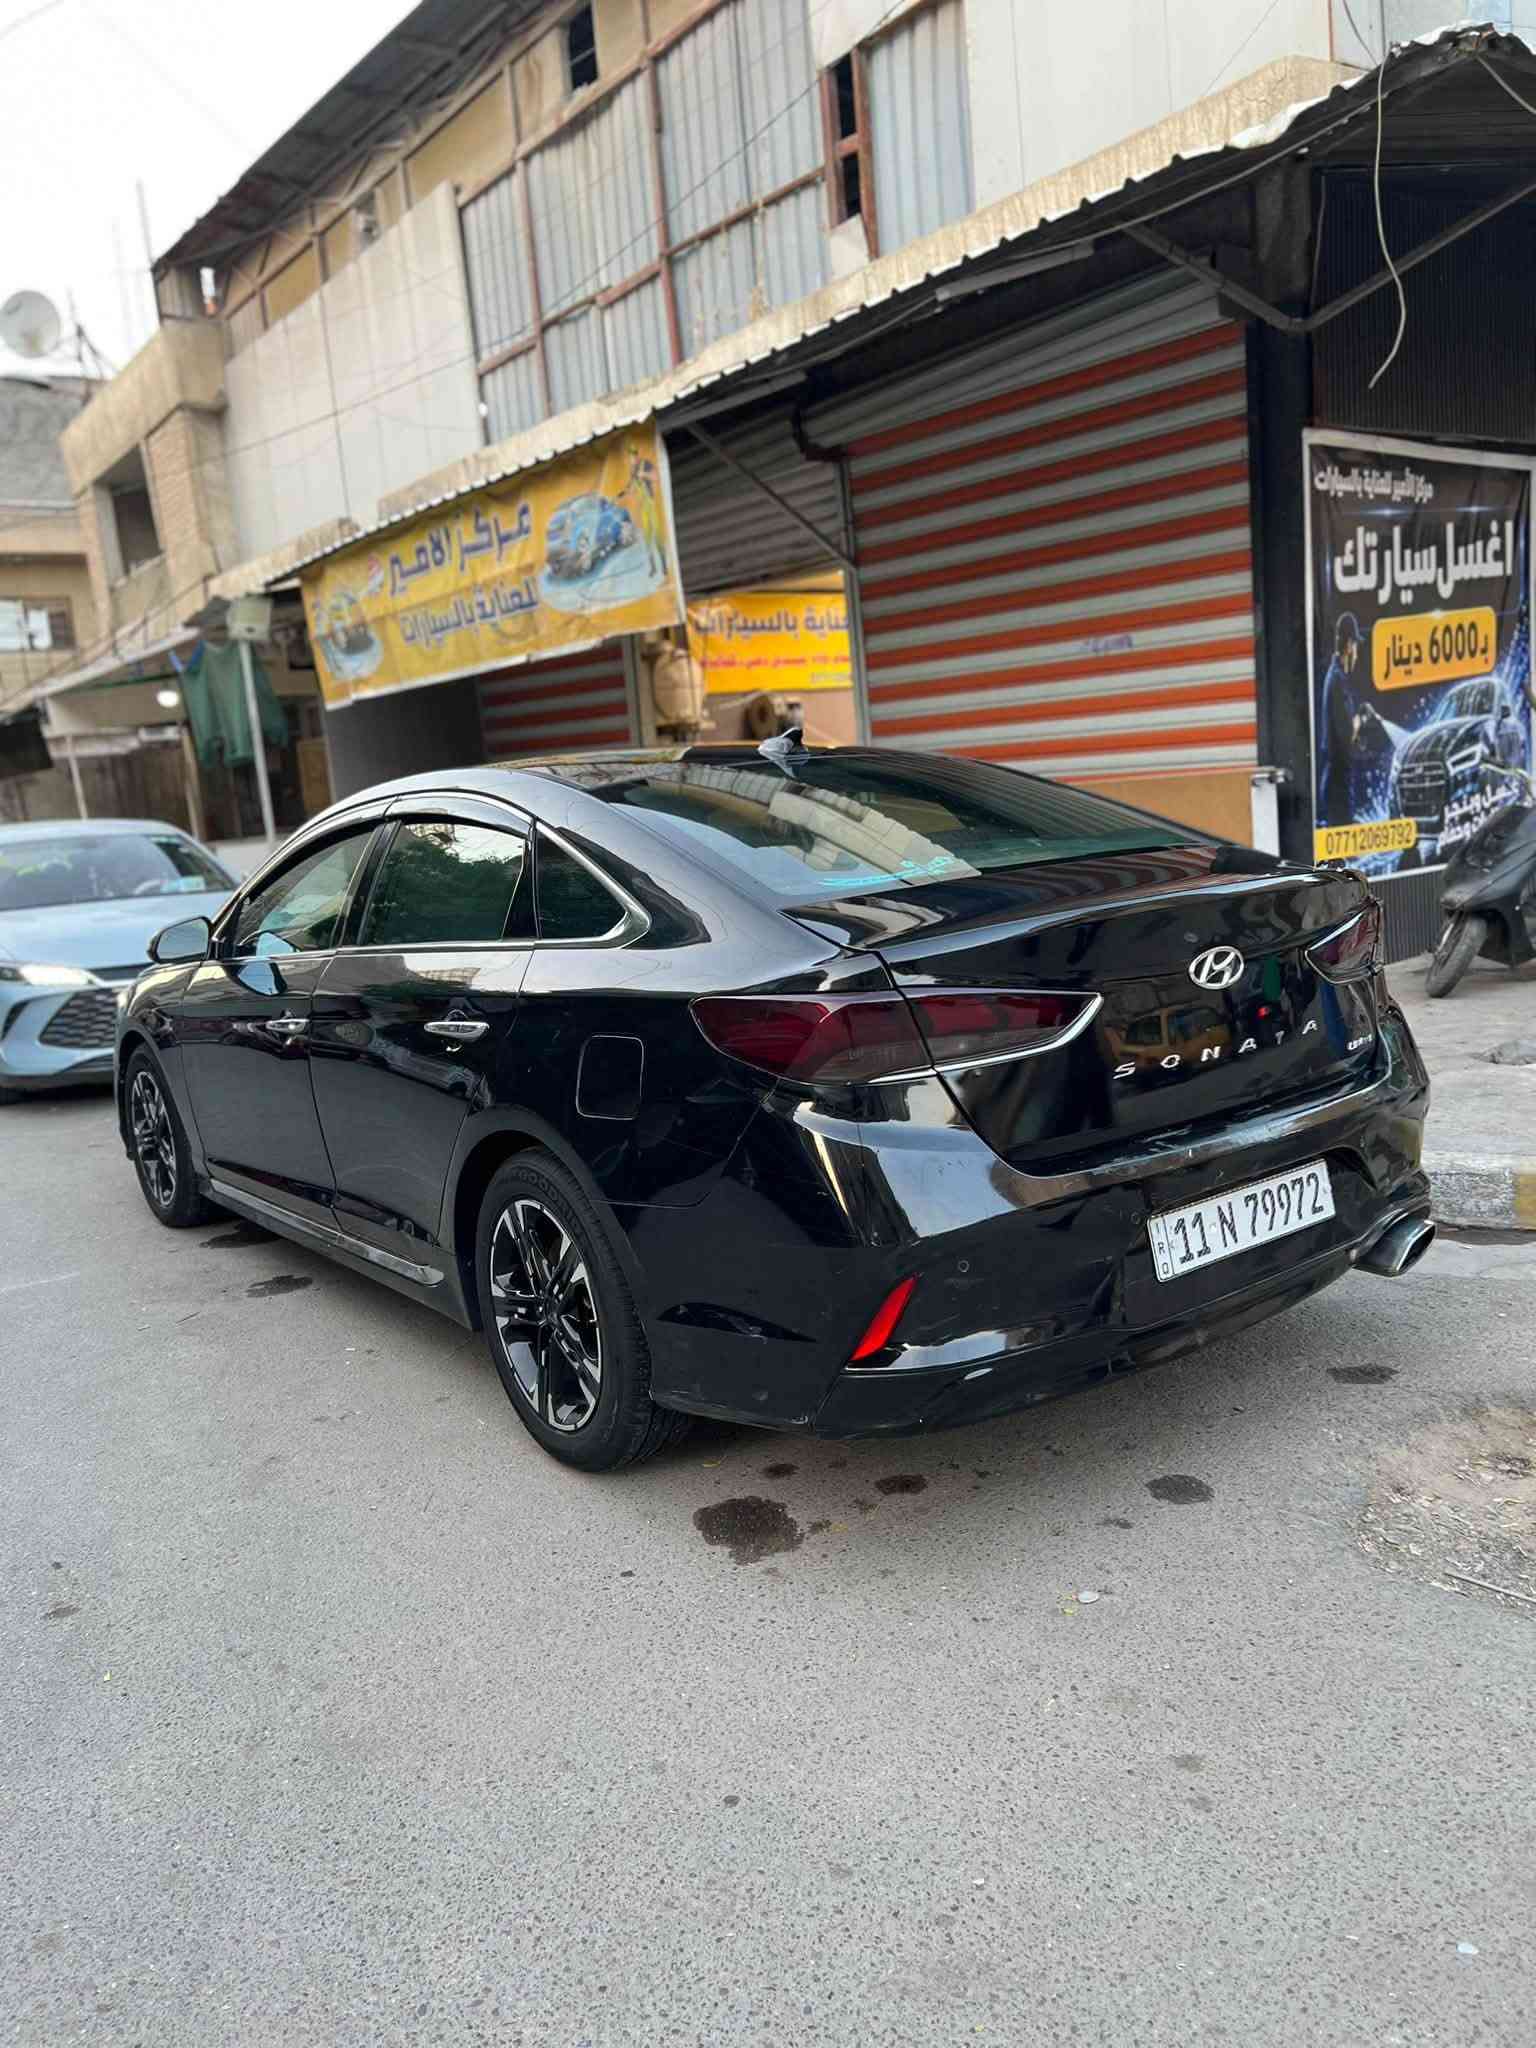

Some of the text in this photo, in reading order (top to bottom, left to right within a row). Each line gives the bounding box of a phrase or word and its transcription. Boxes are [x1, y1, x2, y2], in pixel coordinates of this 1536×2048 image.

[1314, 465, 1363, 499] بالسيارات
[456, 503, 531, 573] مركز
[1334, 519, 1513, 605] اغسل سيارتك
[400, 576, 539, 648] للعناية بالسيارات
[1384, 634, 1423, 678] دينار
[1112, 1019, 1319, 1080] SONATA
[1173, 1172, 1324, 1265] 11 N 79972
